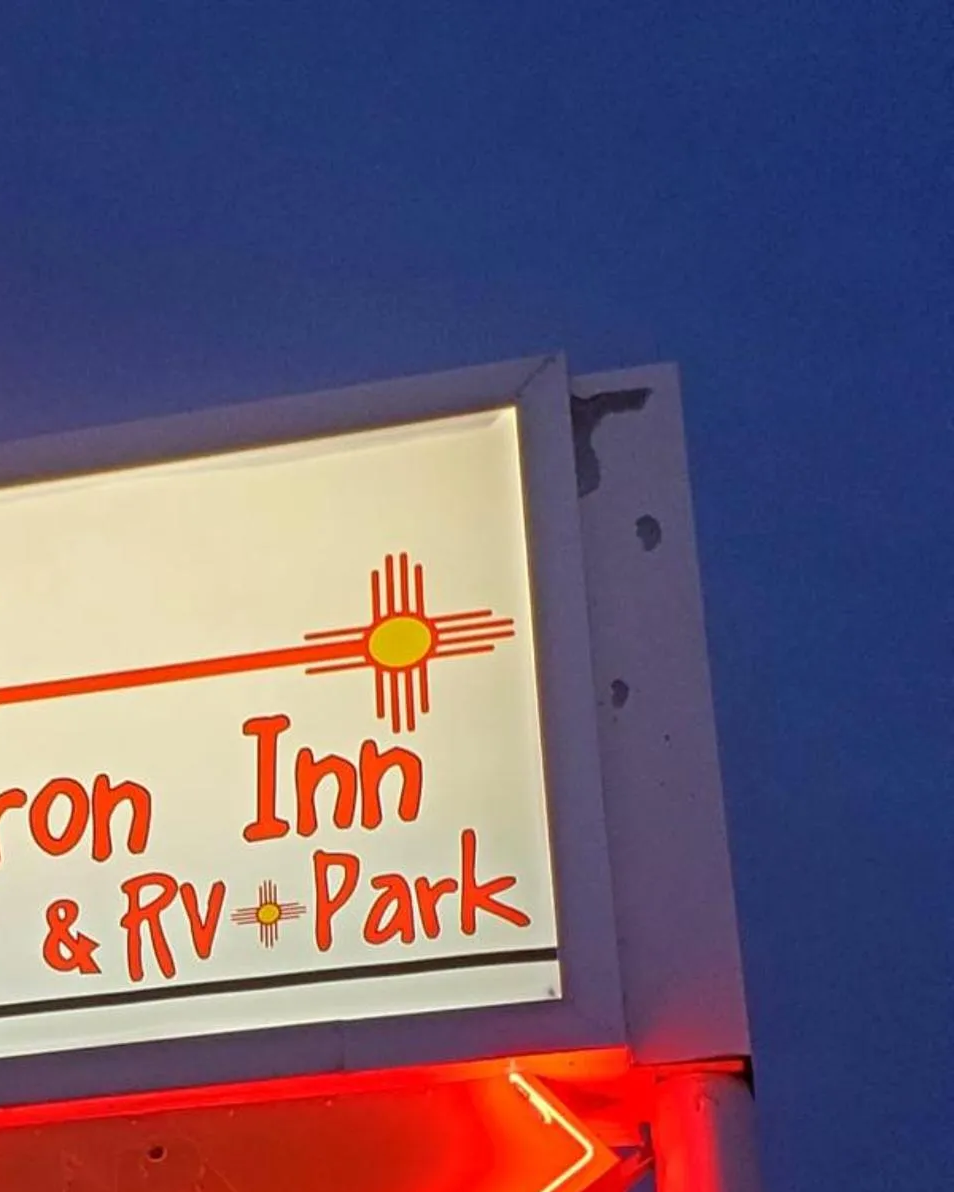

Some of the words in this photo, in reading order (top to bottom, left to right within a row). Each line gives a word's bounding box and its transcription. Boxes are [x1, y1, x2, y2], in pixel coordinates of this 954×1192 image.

[242, 713, 422, 842] Inn
[42, 898, 101, 974] &
[120, 872, 226, 982] RV
[312, 828, 531, 952] Park
